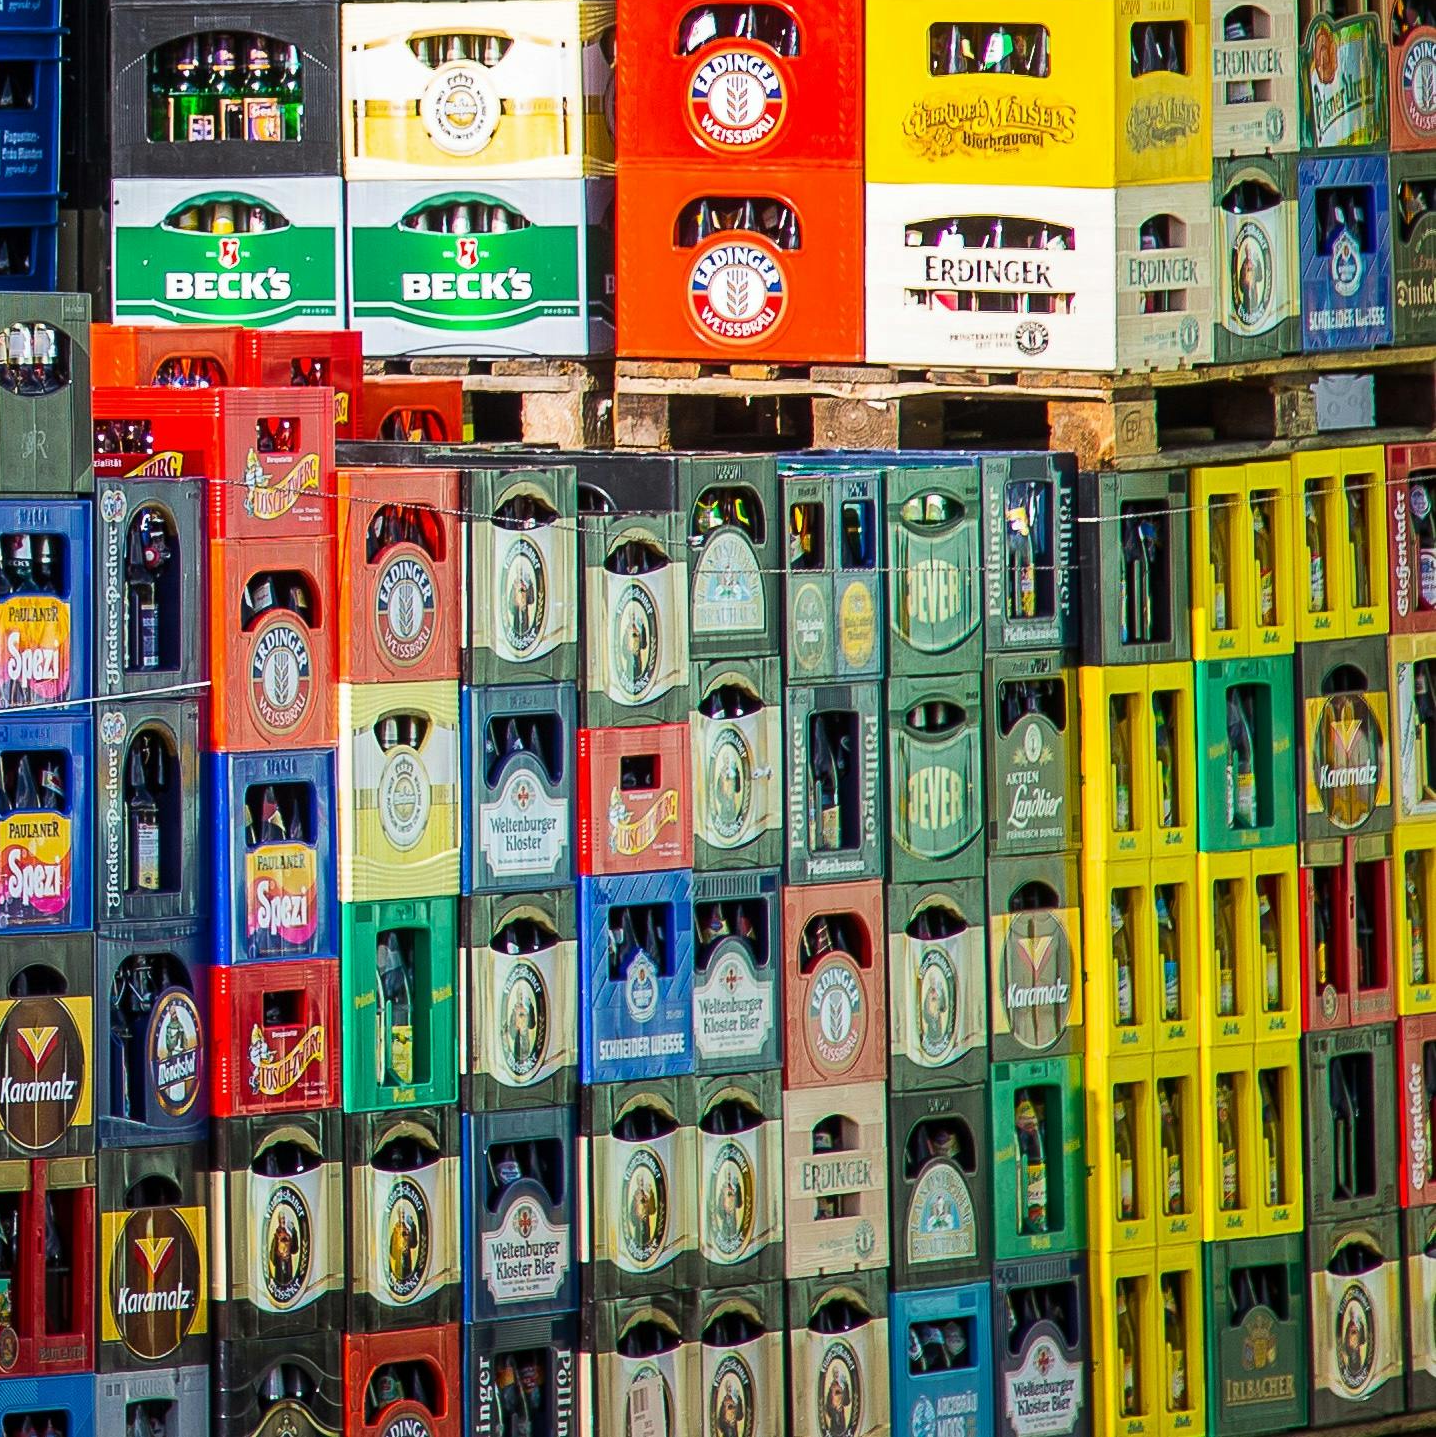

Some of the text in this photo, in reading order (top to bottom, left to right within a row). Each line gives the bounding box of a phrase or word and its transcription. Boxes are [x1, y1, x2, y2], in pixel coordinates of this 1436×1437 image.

[403, 268, 533, 301] BECK'S
[924, 255, 1053, 288] ERDINGER
[989, 487, 1001, 617] Pöllinger
[8, 605, 59, 624] PAULANER
[107, 527, 119, 687] Hacker-Pschorr
[7, 632, 61, 686] Spezi
[1319, 761, 1379, 790] Karamalz
[908, 765, 959, 832] JEVER
[1007, 786, 1063, 828] Landbier
[490, 815, 557, 836] Weltenburger
[506, 832, 542, 852] Kloster
[699, 995, 764, 1018] Weltenburger
[1007, 982, 1068, 1008] Karamalz
[703, 1012, 760, 1033] Kloster Bier
[600, 1032, 684, 1060] SCHNEIDER WEISSE
